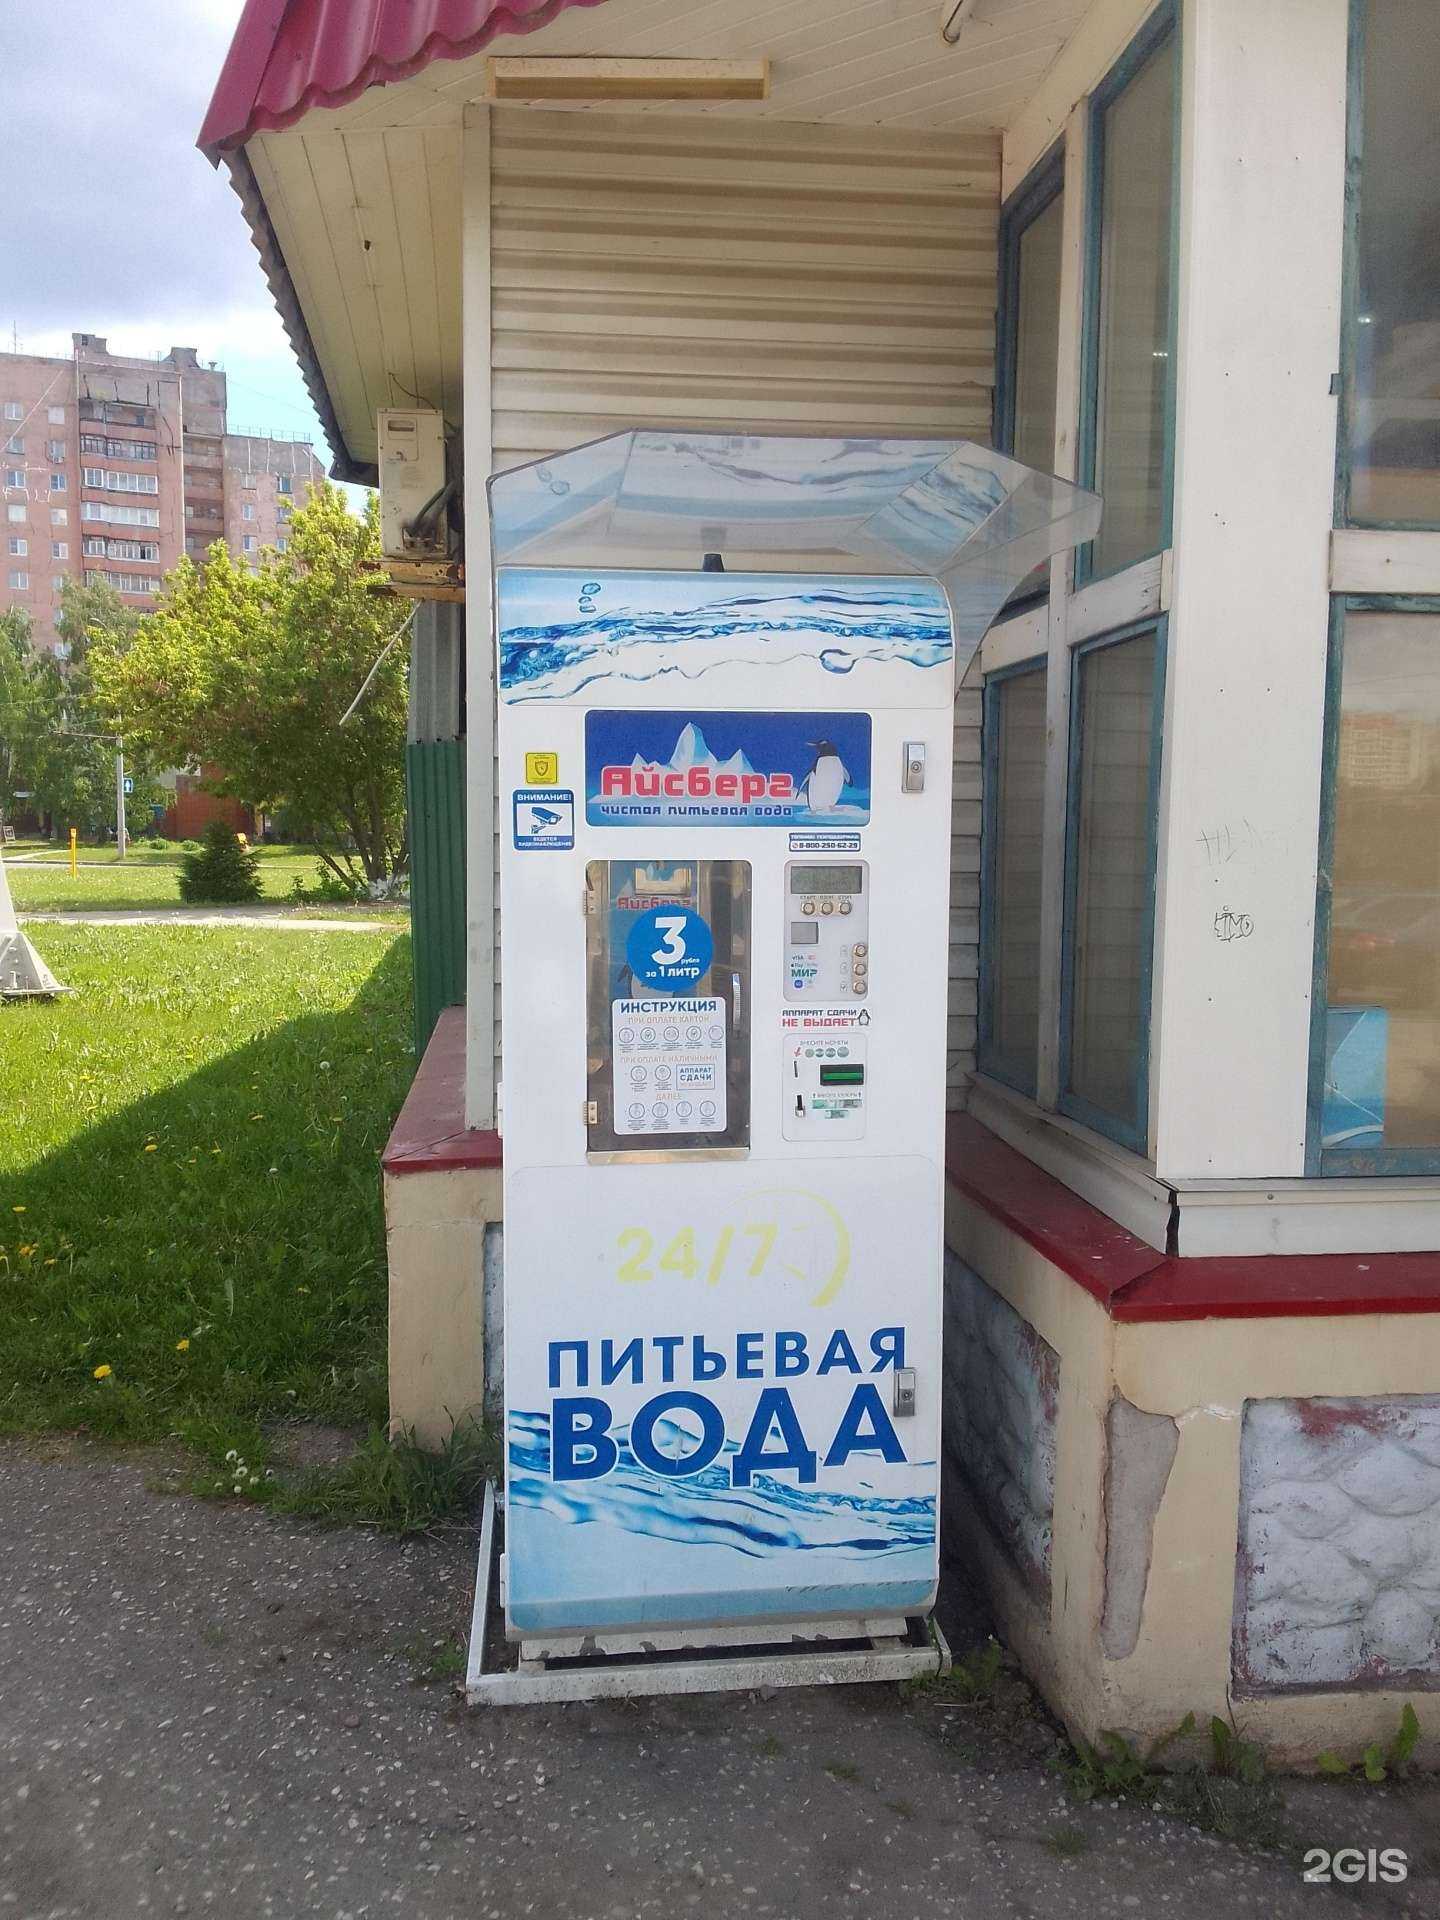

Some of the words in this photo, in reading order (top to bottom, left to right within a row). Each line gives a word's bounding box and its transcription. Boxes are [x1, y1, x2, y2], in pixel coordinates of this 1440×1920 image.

[602, 766, 792, 803] Айсберг
[517, 793, 572, 801] ВНИМАНИЕ!
[601, 805, 661, 816] чистая
[668, 805, 748, 816] питьевая
[754, 804, 792, 816] вода
[651, 916, 687, 965] 3
[659, 965, 665, 977] 1
[667, 966, 700, 979] литр
[791, 968, 818, 978] МИР
[620, 1000, 717, 1014] ИНСТРУКЦИЯ
[782, 1009, 824, 1017] АППАРАТ
[827, 1009, 857, 1017] СДАЧИ
[782, 1018, 799, 1026] НЕ
[803, 1017, 856, 1027] ВЫДАЕТ
[616, 1223, 778, 1285] 24/7
[549, 1327, 906, 1388] ПИТЬЕВАЯ
[552, 1382, 908, 1487] ВОДА
